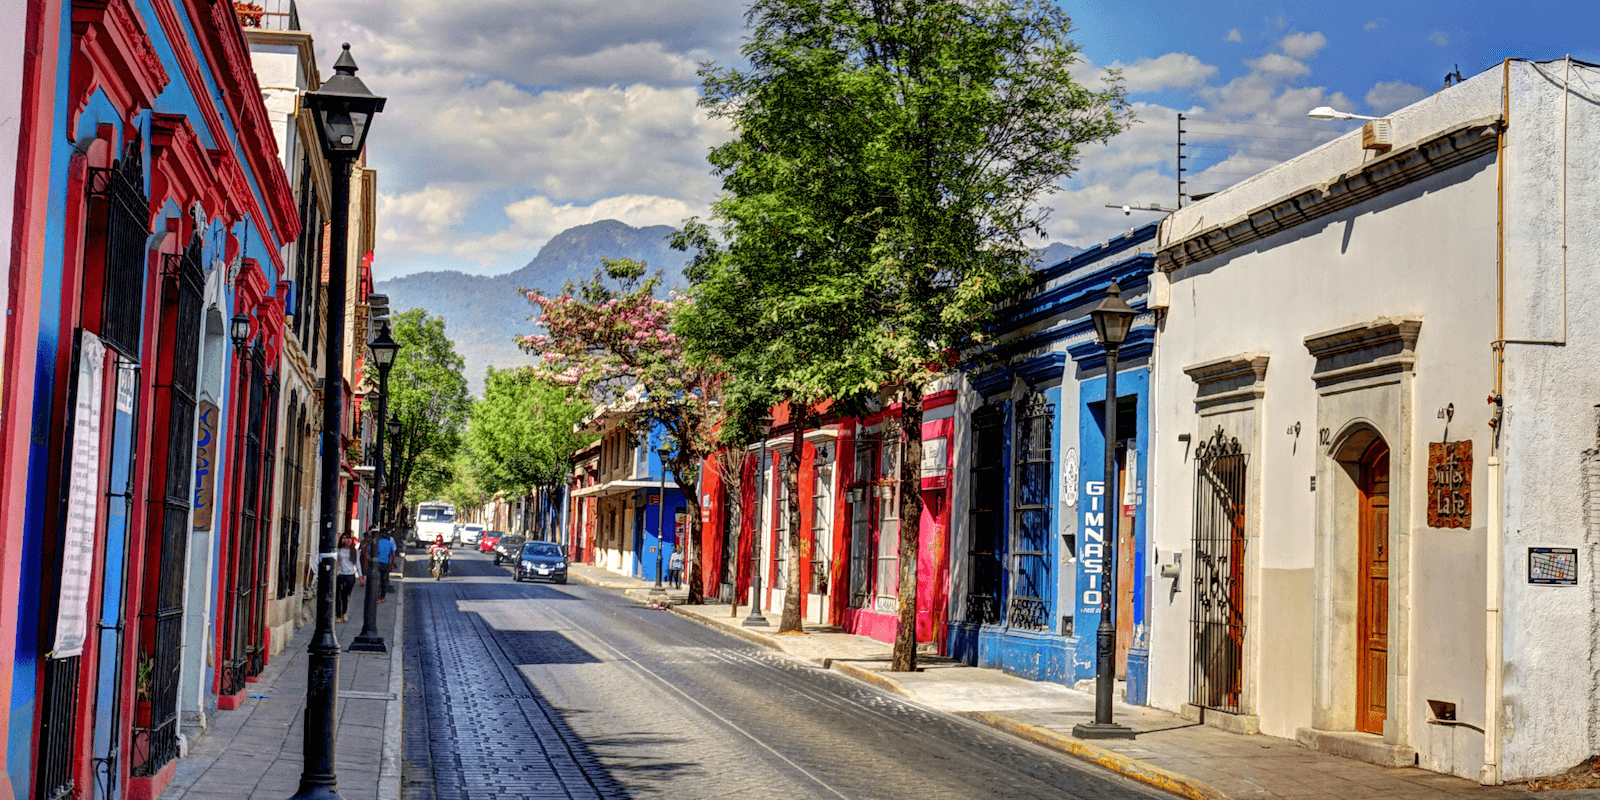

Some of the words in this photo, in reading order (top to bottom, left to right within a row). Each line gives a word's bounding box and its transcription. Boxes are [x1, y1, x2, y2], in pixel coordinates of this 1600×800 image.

[1319, 428, 1330, 446] 102
[193, 408, 212, 529] OSTE
[1433, 453, 1464, 491] Suites
[1437, 490, 1450, 515] La
[1453, 491, 1465, 515] Fe
[1083, 481, 1105, 605] GIMNASIO
